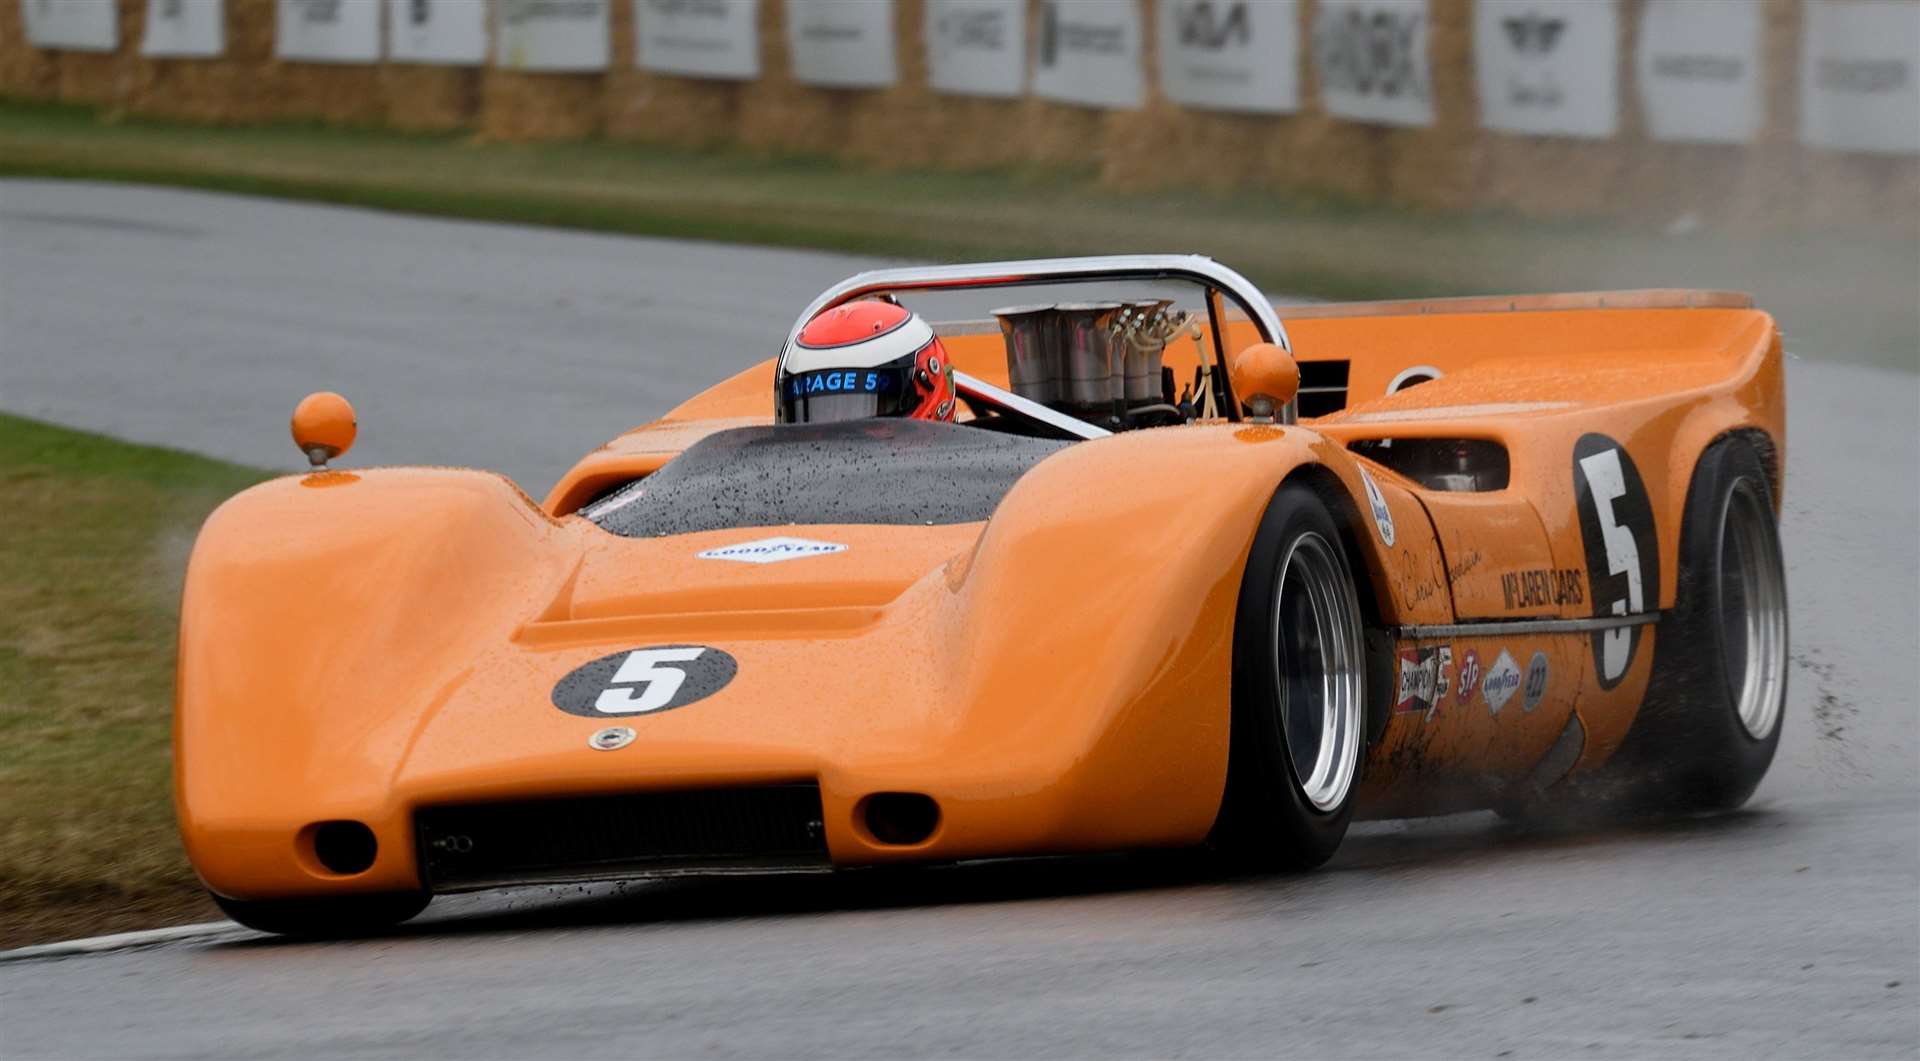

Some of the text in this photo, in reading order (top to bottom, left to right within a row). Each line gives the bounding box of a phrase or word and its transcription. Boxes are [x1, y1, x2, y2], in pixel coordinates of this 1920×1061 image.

[1550, 568, 1584, 605] CARS
[1579, 447, 1644, 681] 5
[594, 647, 707, 714] 5
[1458, 655, 1480, 696] STP
